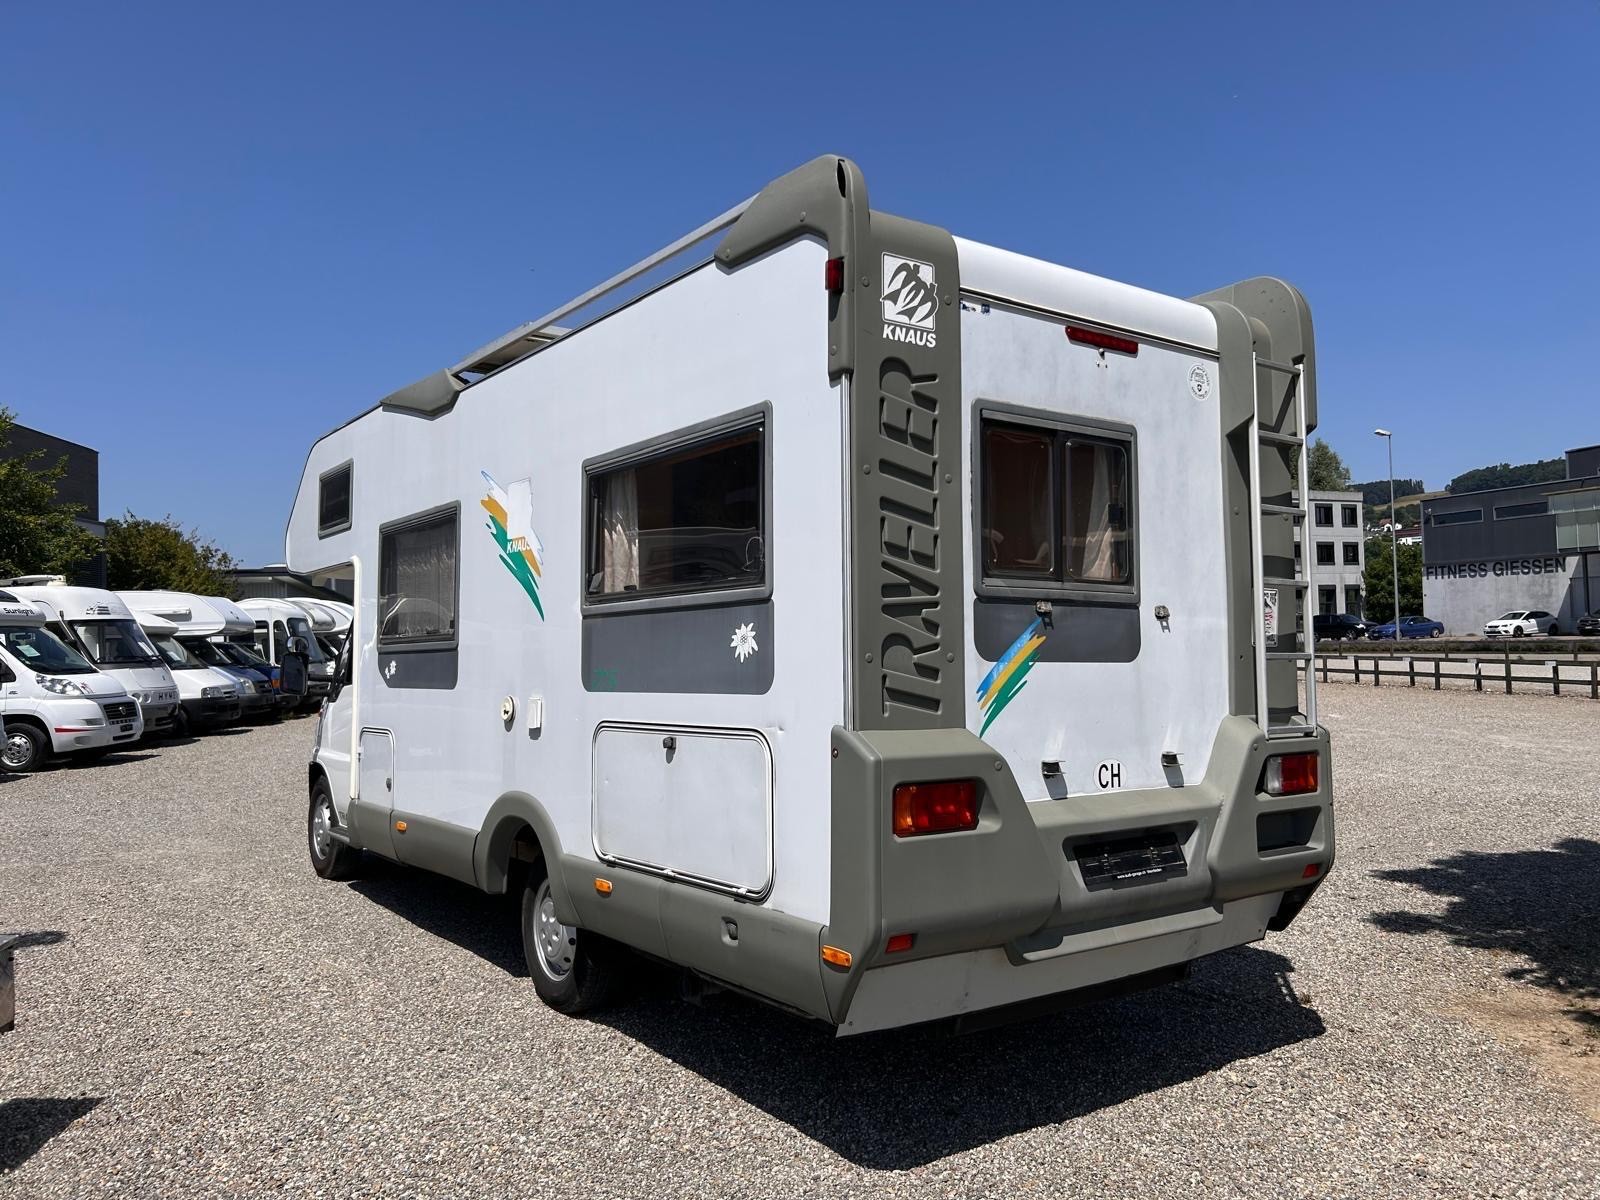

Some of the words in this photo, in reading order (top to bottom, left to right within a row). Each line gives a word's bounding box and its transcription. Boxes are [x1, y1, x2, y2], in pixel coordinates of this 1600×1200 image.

[882, 324, 937, 348] KNAUS
[879, 356, 941, 716] TRAVELLER
[1425, 564, 1488, 580] FITNESS
[1492, 558, 1567, 577] GIESSEN
[1098, 762, 1121, 788] CH
